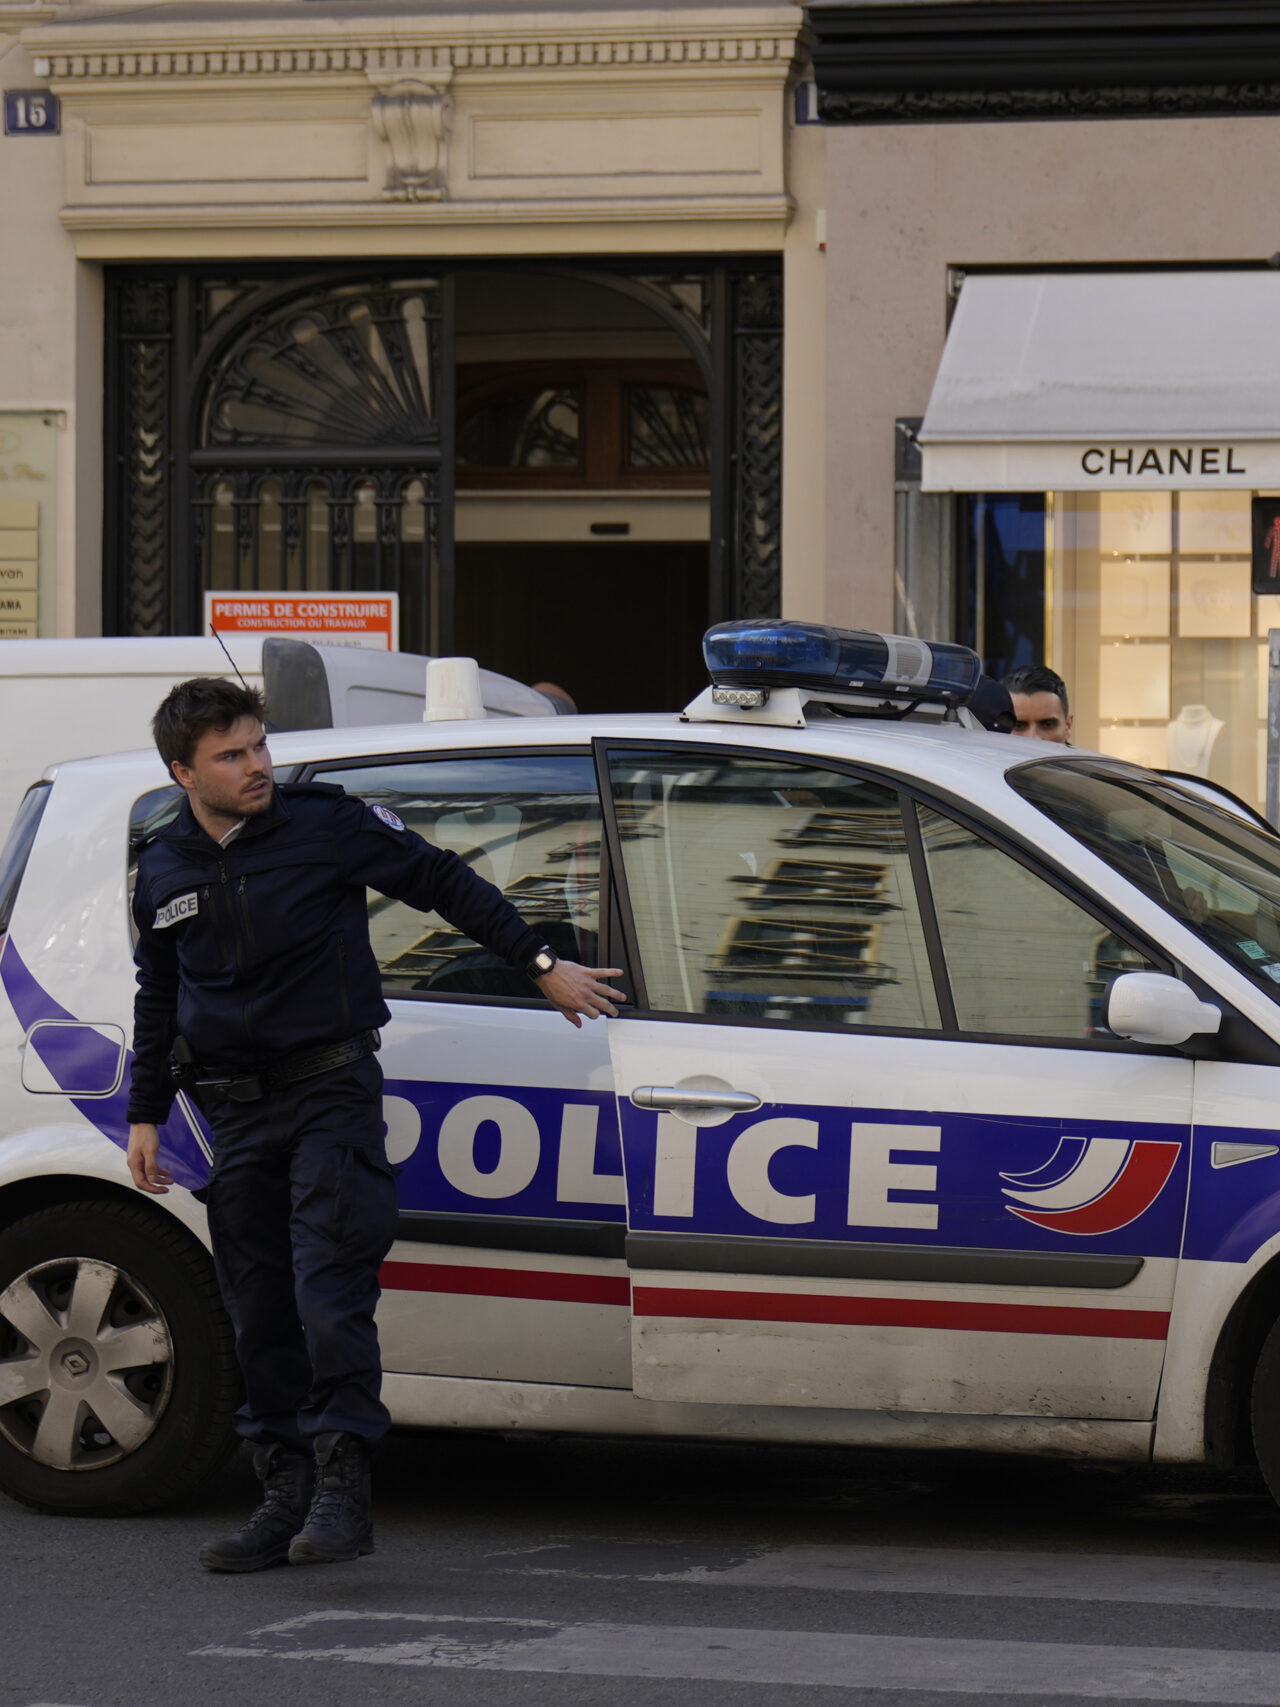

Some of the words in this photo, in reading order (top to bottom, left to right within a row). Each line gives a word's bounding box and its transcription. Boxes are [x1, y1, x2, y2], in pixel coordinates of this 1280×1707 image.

[16, 97, 48, 129] 15
[1081, 447, 1247, 475] CHANEL
[215, 603, 270, 617] PERMIS
[274, 603, 294, 617] DE
[299, 603, 388, 618] CONSTRUIRE
[237, 618, 306, 629] CONSTRUCTION
[308, 618, 323, 629] OU
[324, 618, 367, 629] TRAVAUX
[156, 897, 197, 925] POLICE
